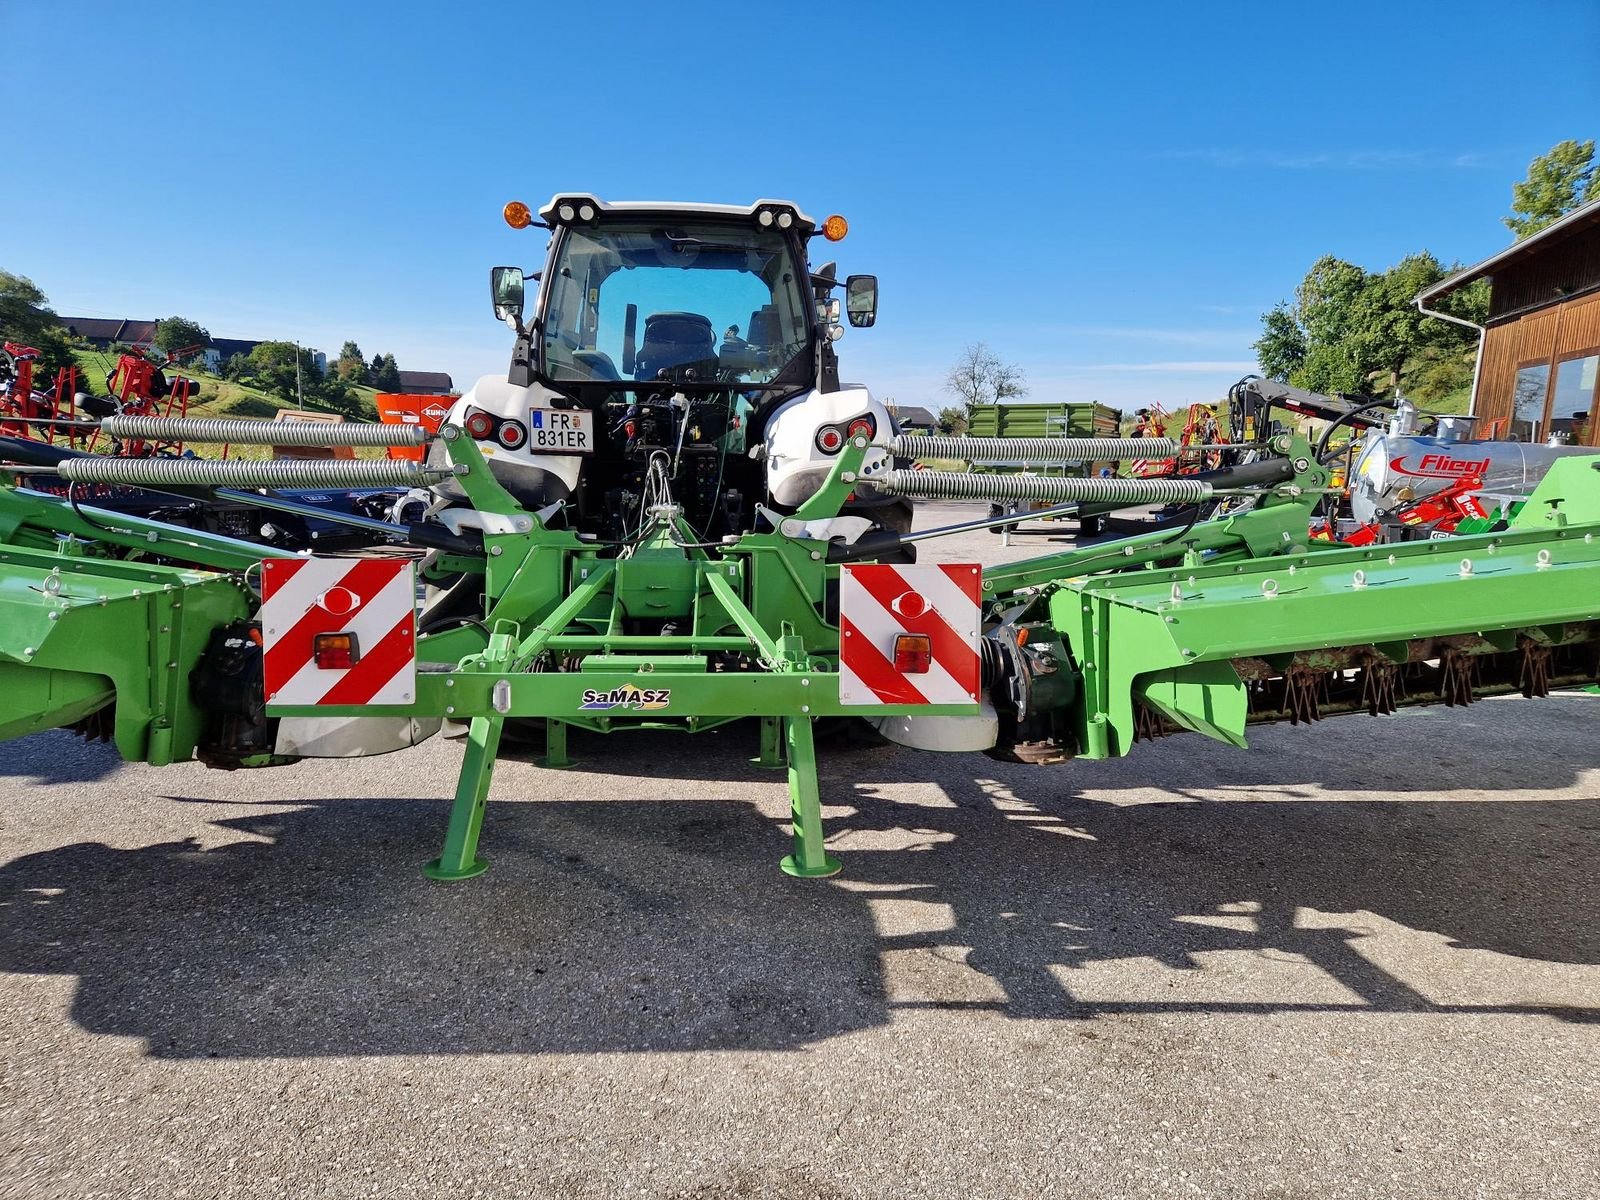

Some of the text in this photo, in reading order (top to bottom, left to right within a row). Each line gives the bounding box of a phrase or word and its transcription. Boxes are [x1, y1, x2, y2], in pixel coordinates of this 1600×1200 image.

[551, 413, 570, 430] FR
[537, 430, 586, 448] 831ER
[1419, 454, 1491, 475] Fliegl
[582, 689, 671, 704] SaMASZ
